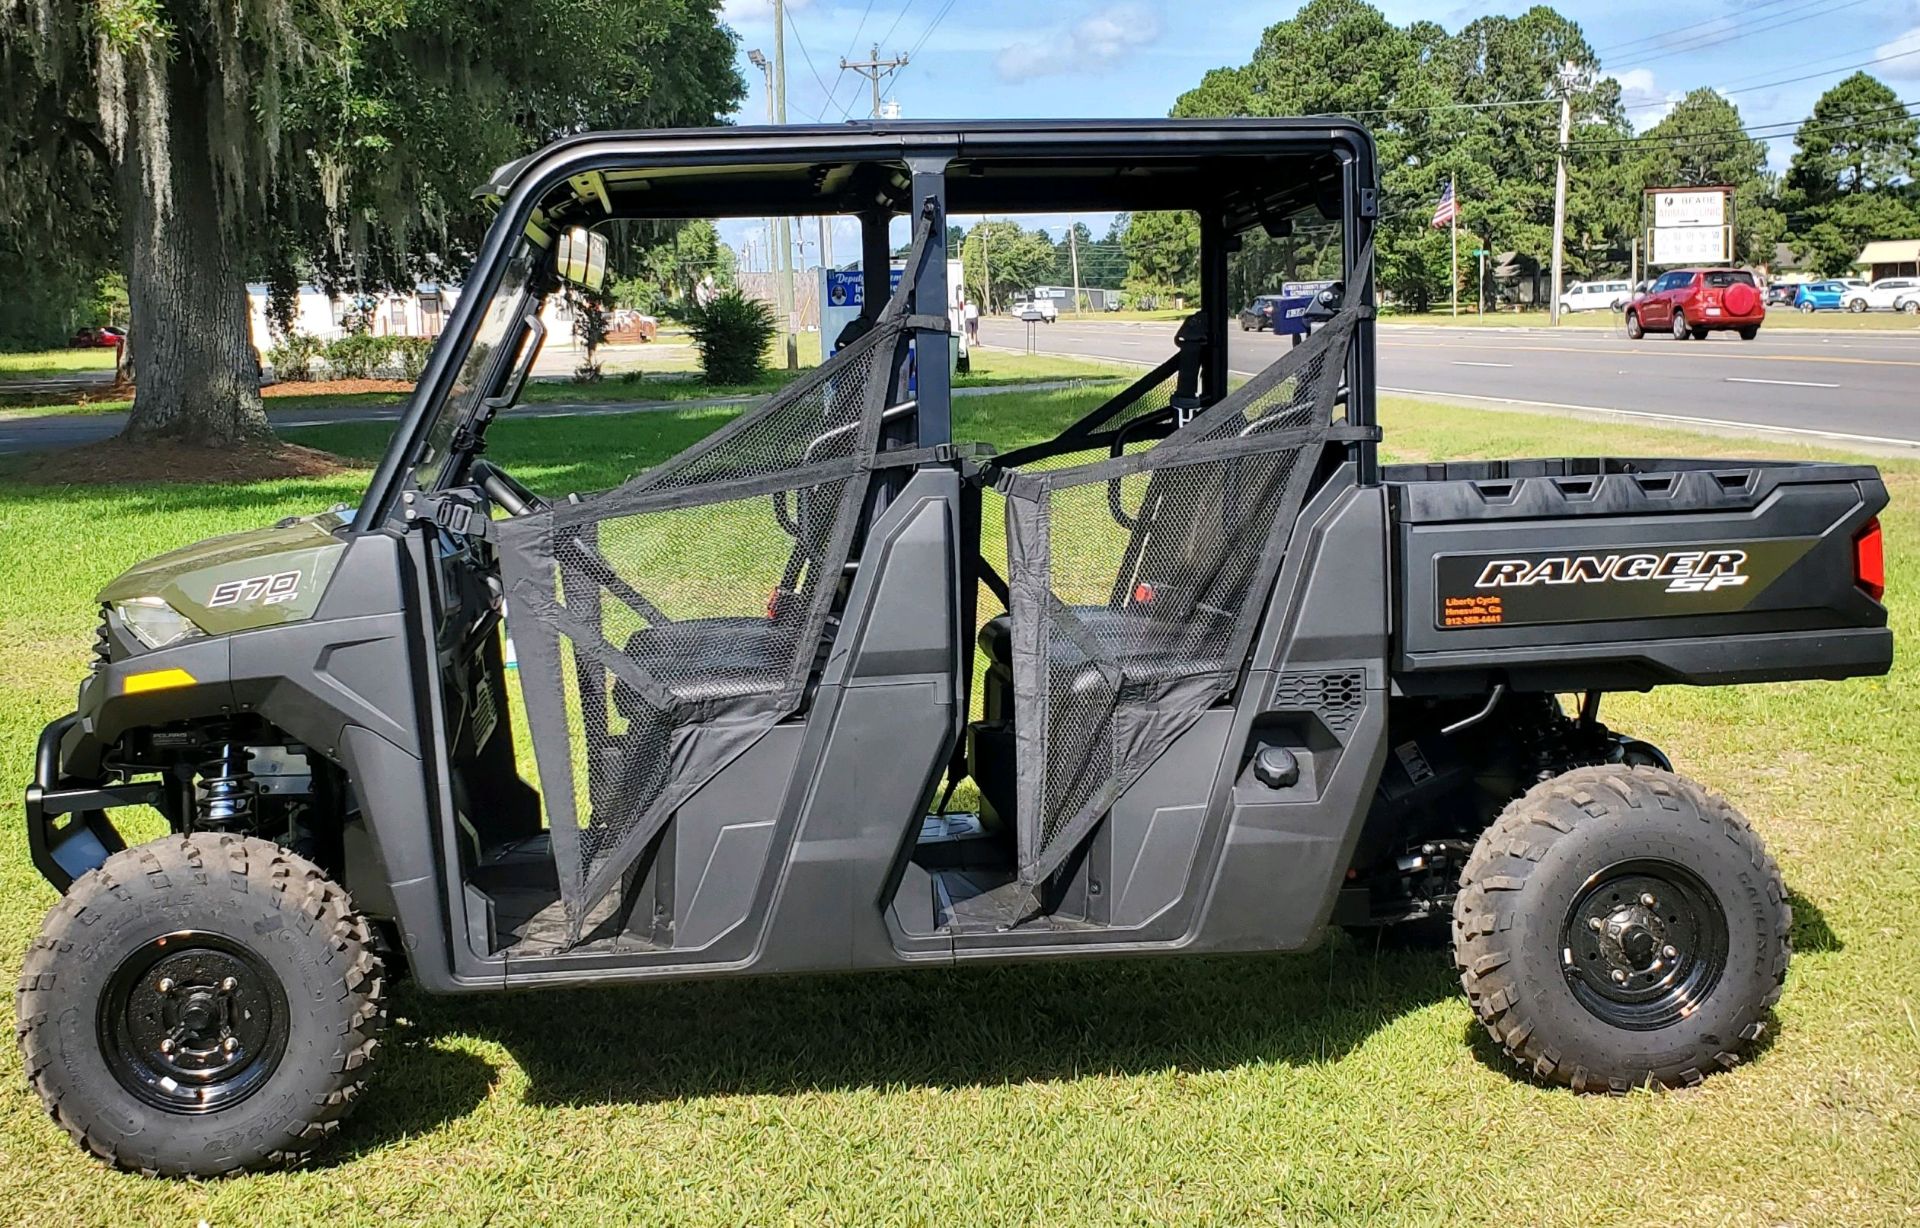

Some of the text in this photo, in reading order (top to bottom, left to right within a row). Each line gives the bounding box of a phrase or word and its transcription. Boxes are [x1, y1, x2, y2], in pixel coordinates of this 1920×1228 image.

[1475, 549, 1748, 588] RANGER
[207, 569, 302, 608] 570
[1665, 575, 1749, 593] SP
[1445, 596, 1501, 606] Liberty Cycle
[1488, 605, 1502, 614] Ga
